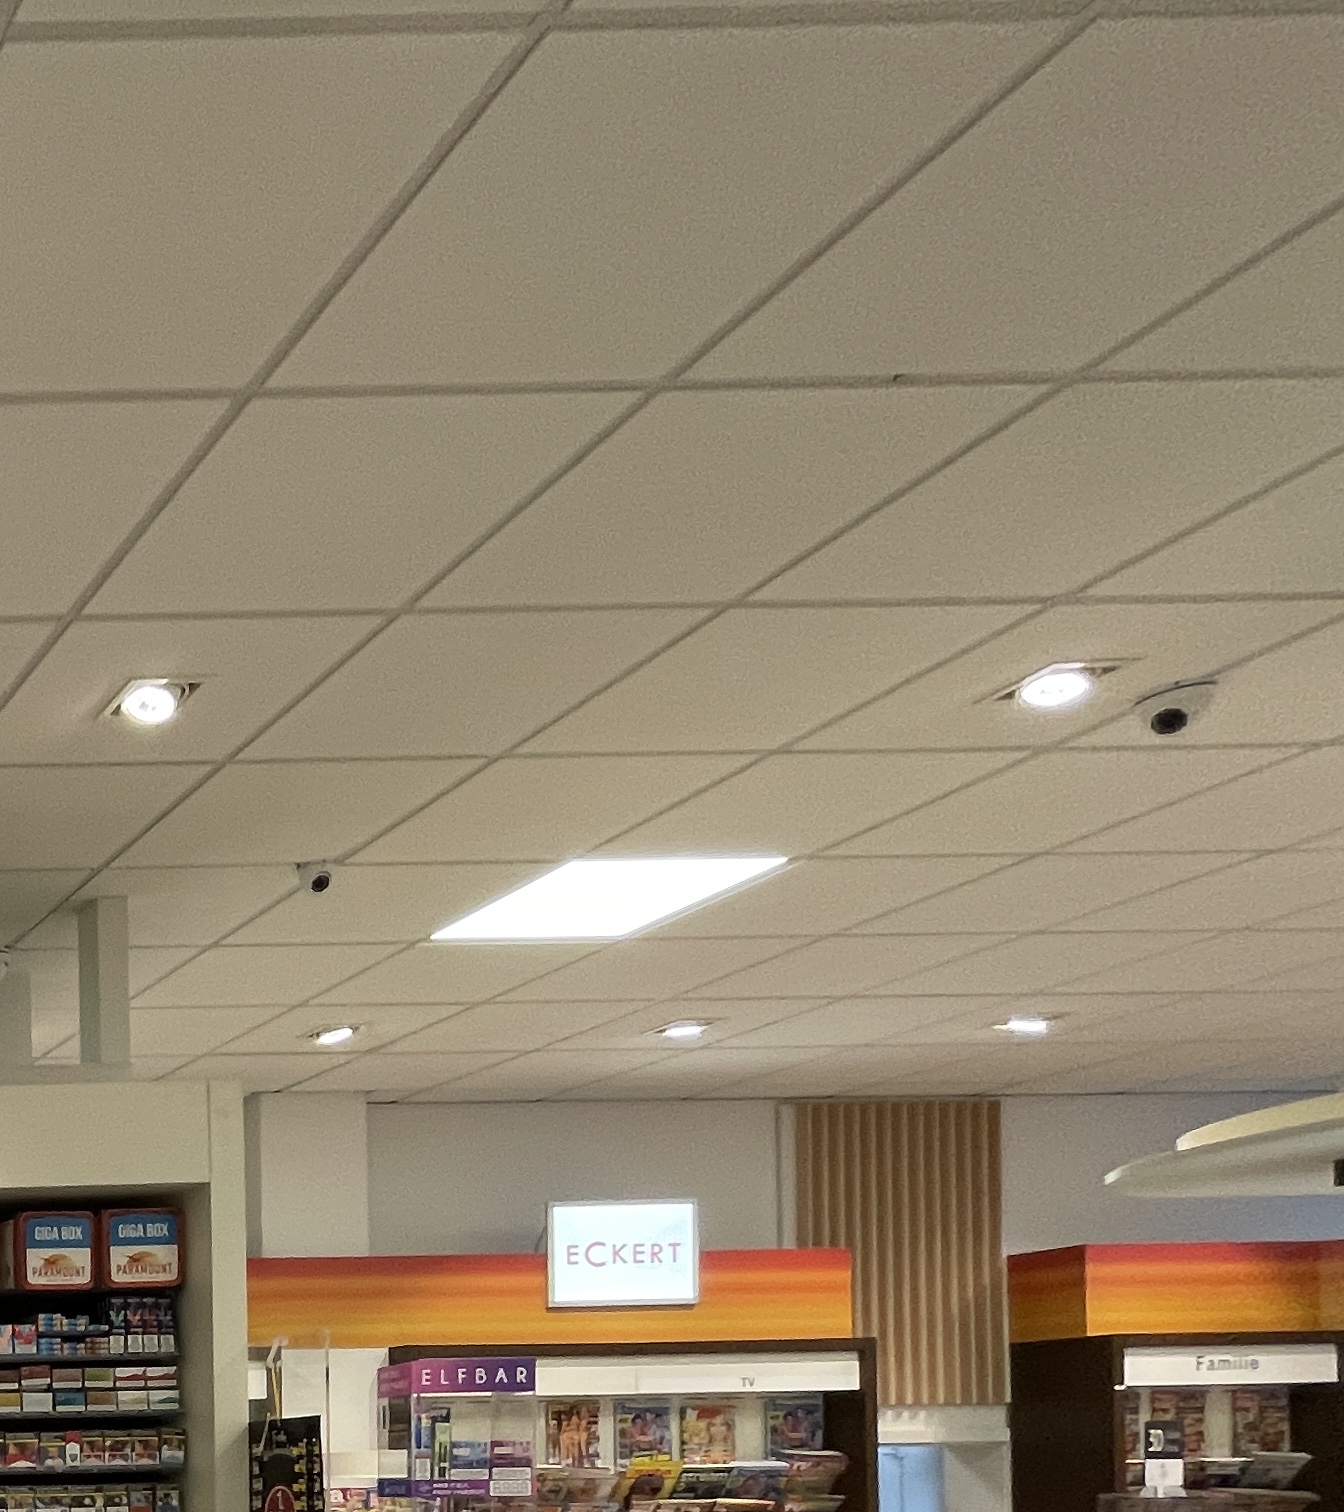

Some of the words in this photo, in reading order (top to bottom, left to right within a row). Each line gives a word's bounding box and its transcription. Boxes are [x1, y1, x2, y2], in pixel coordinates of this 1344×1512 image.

[35, 1227, 58, 1240] GIGA
[62, 1226, 82, 1239] BOX
[119, 1224, 143, 1237] GIGA
[147, 1223, 168, 1237] BOX
[567, 1241, 681, 1267] ECKERT
[32, 1265, 86, 1279] PARAMOUNT
[116, 1263, 172, 1276] PARAMOUNT
[1195, 1355, 1259, 1371] Familie
[421, 1367, 527, 1385] ELFBAR
